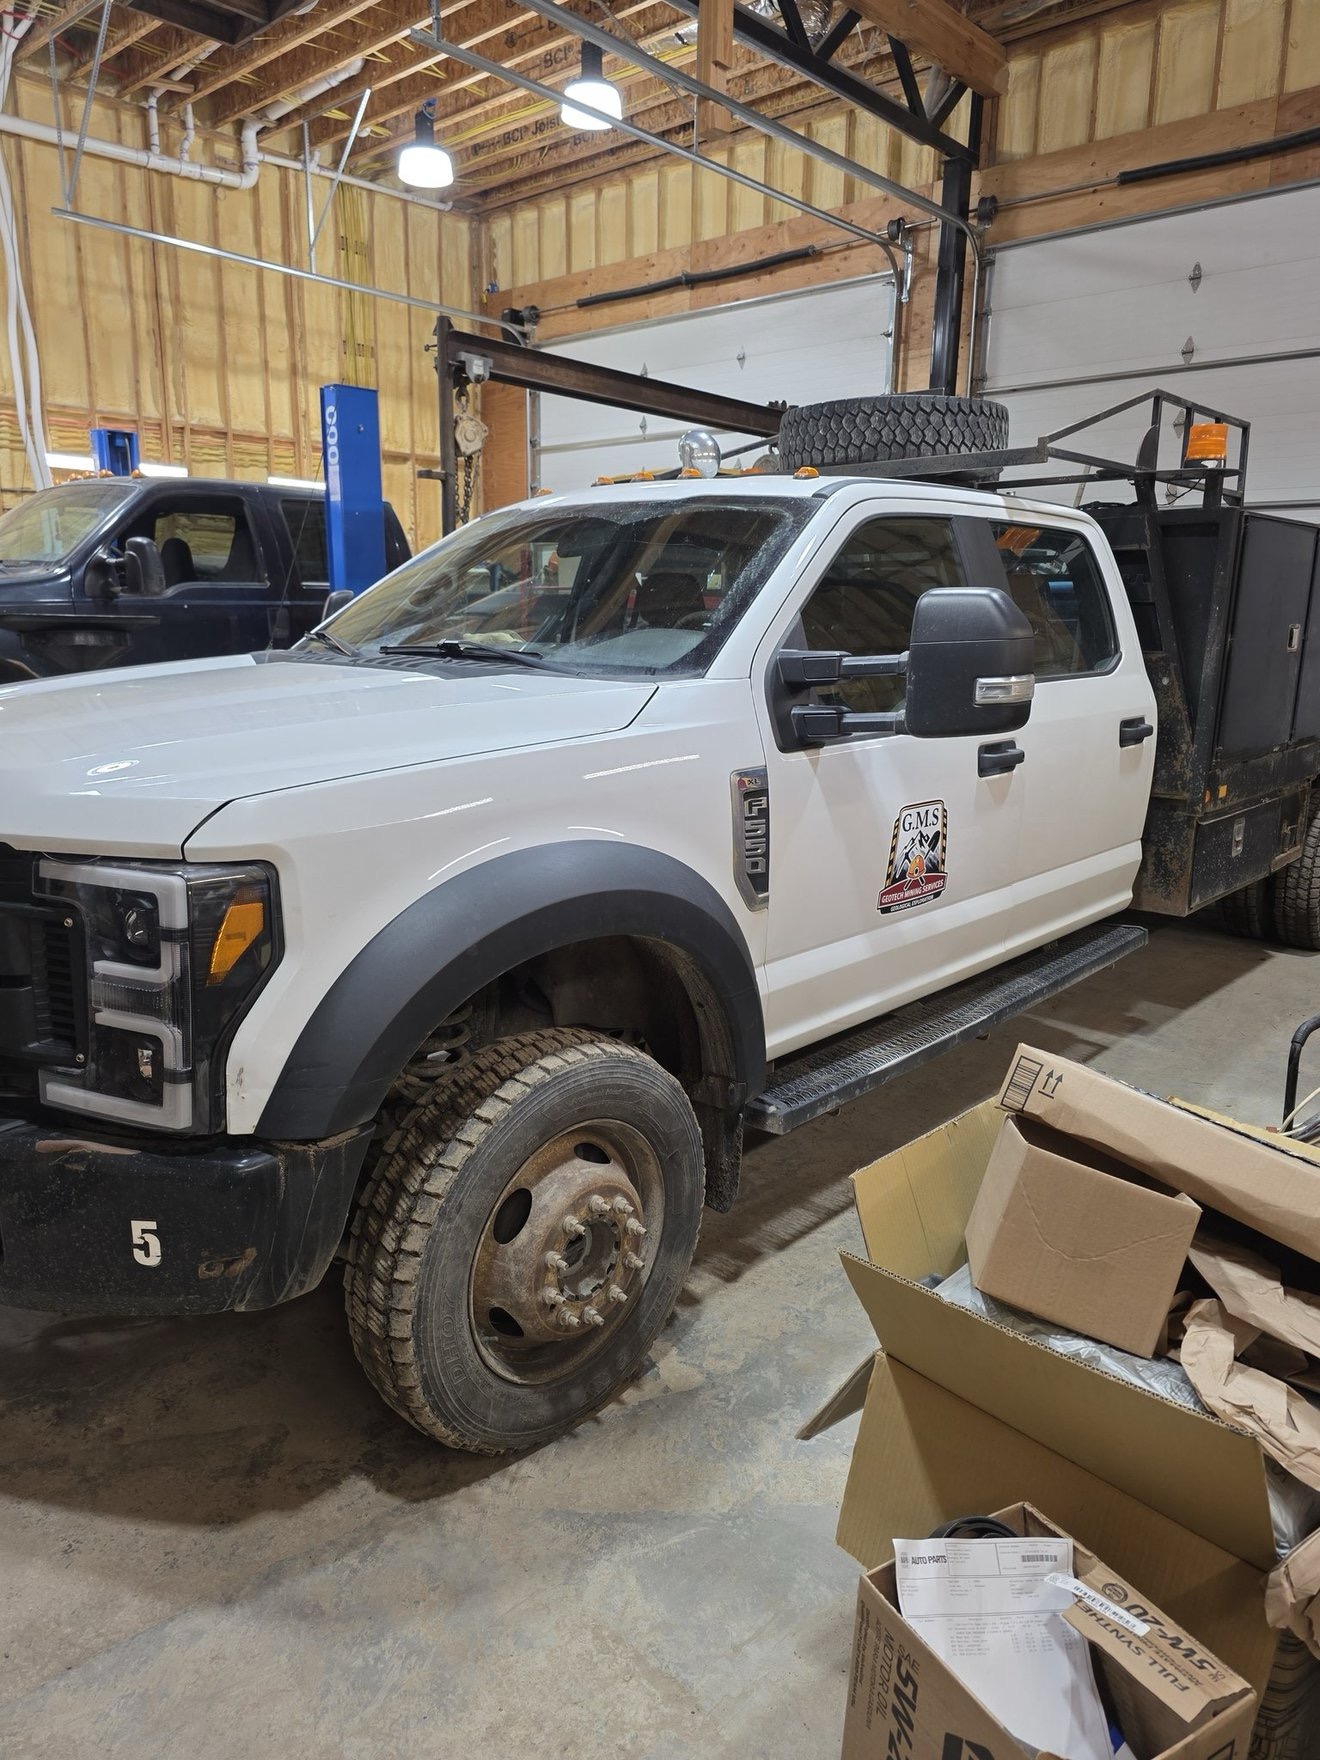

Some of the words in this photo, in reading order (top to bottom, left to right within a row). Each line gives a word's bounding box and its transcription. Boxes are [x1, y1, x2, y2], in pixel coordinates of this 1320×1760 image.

[881, 891, 904, 904] GEOTECH
[904, 886, 922, 898] MINING
[922, 879, 944, 893] SERVICES
[130, 1220, 162, 1267] 5
[911, 1556, 928, 1565] AUTO
[927, 1554, 948, 1564] PARTS
[1124, 1603, 1217, 1671] 5W-20
[880, 1627, 895, 1695] MOTOR
[898, 1644, 920, 1676] SAE
[1148, 1655, 1190, 1691] FULL
[876, 1691, 889, 1720] OIL
[886, 1655, 918, 1760] 5W-2
